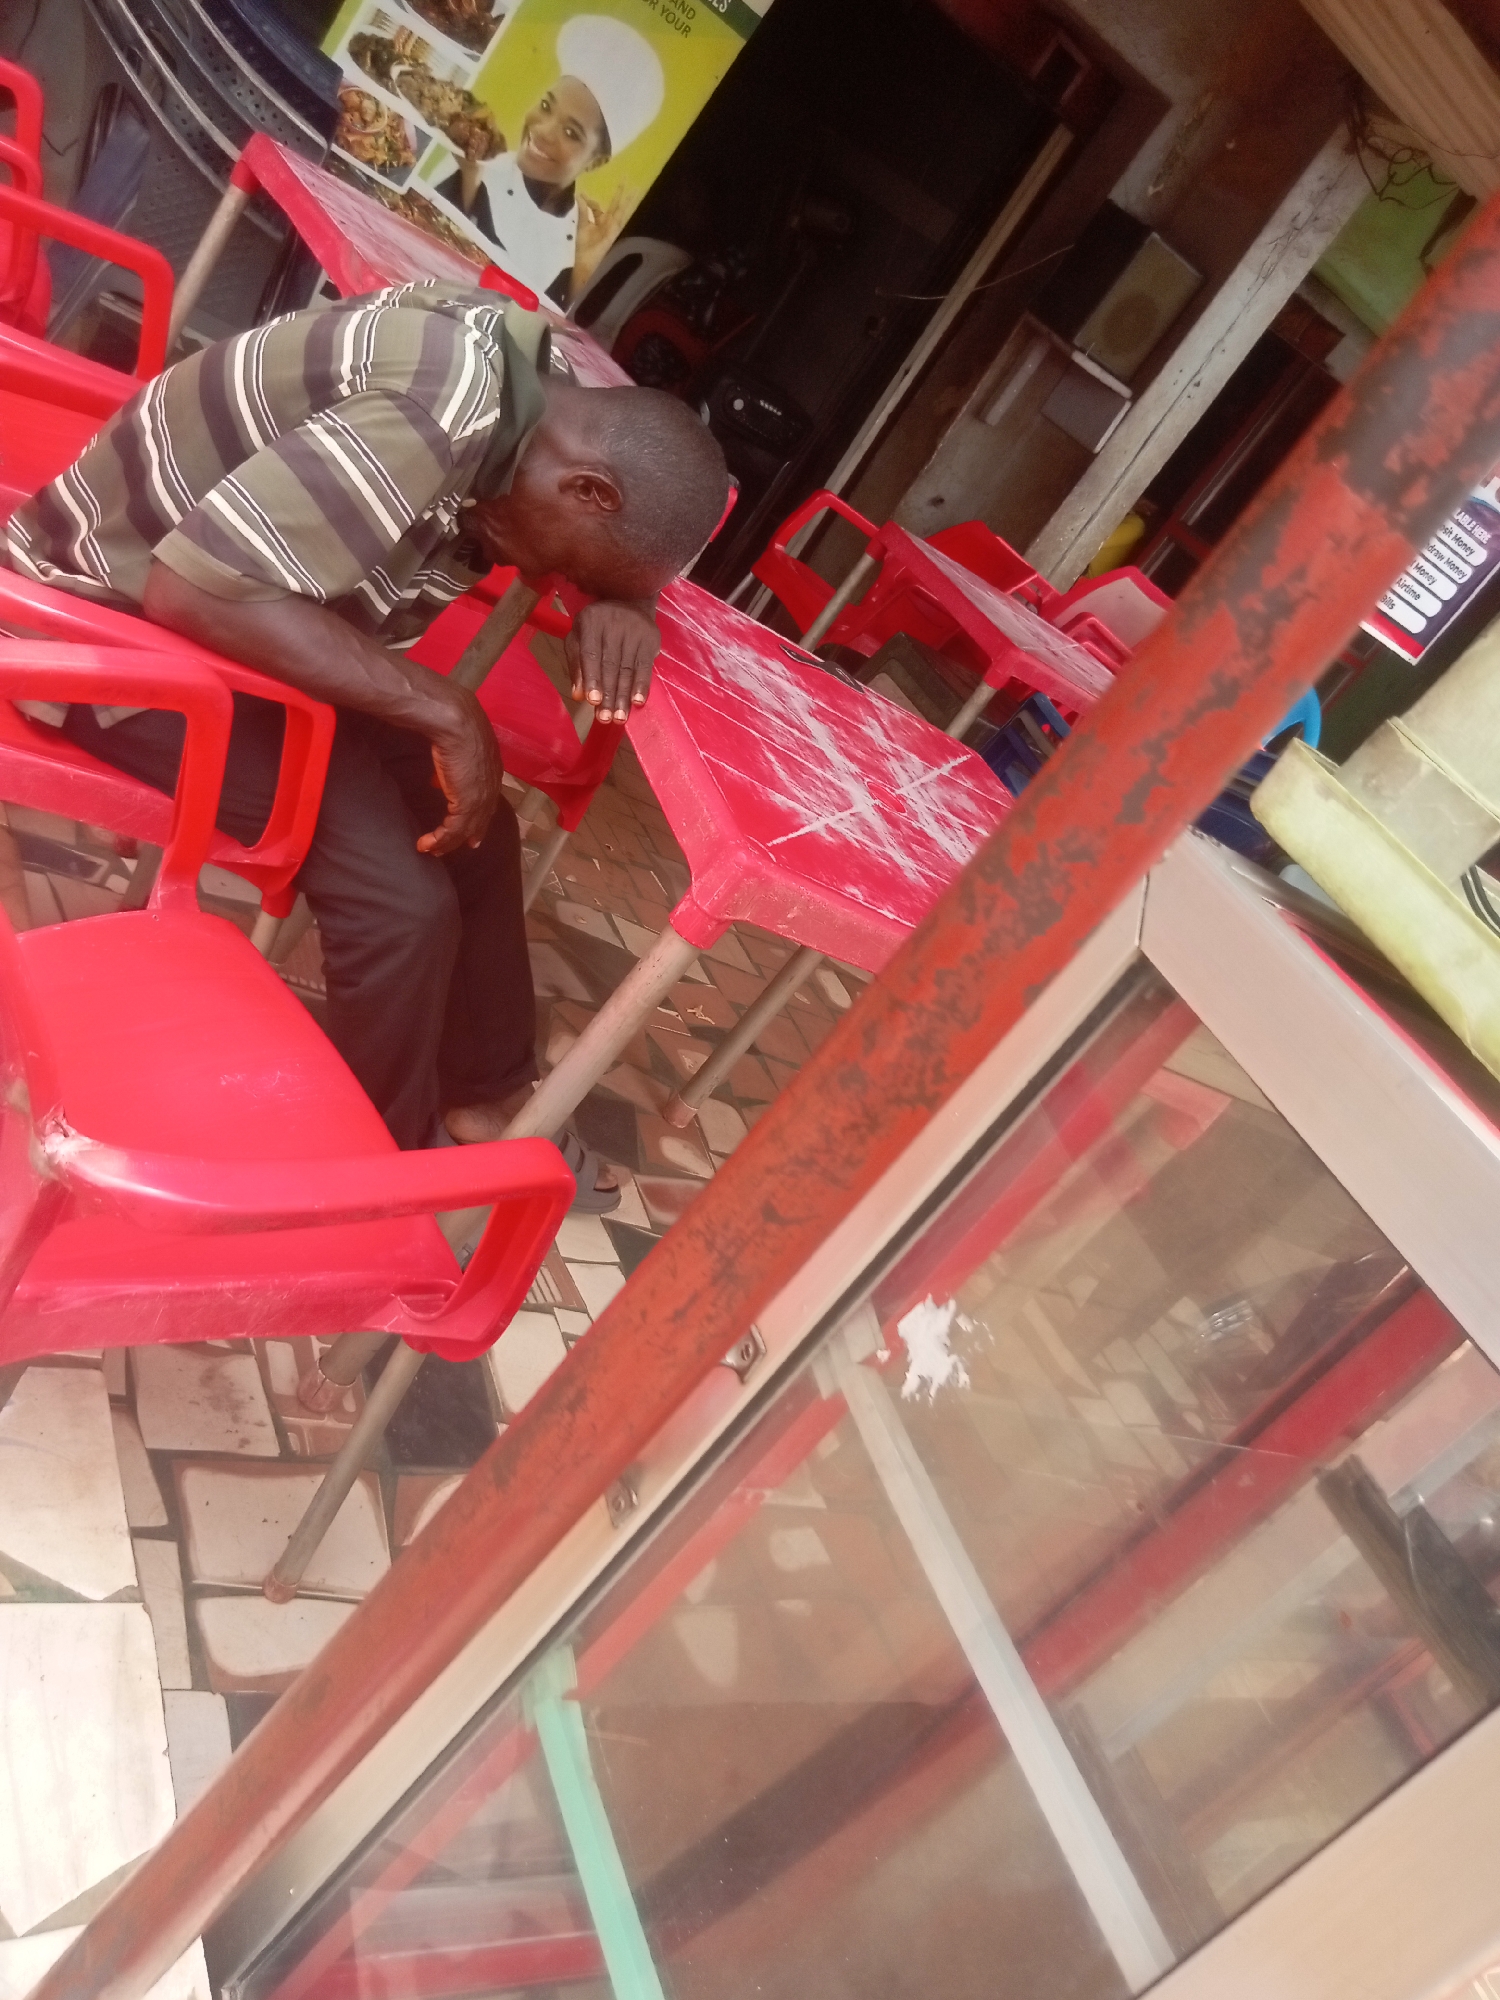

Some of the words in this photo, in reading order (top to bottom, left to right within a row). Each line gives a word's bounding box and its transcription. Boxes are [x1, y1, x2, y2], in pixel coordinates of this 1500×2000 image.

[660, 4, 692, 38] YOUR
[1451, 533, 1475, 557] Money
[1471, 522, 1493, 545] HERE
[1412, 562, 1437, 586] Money
[1443, 557, 1467, 580] Money
[1396, 577, 1421, 601] Airtime
